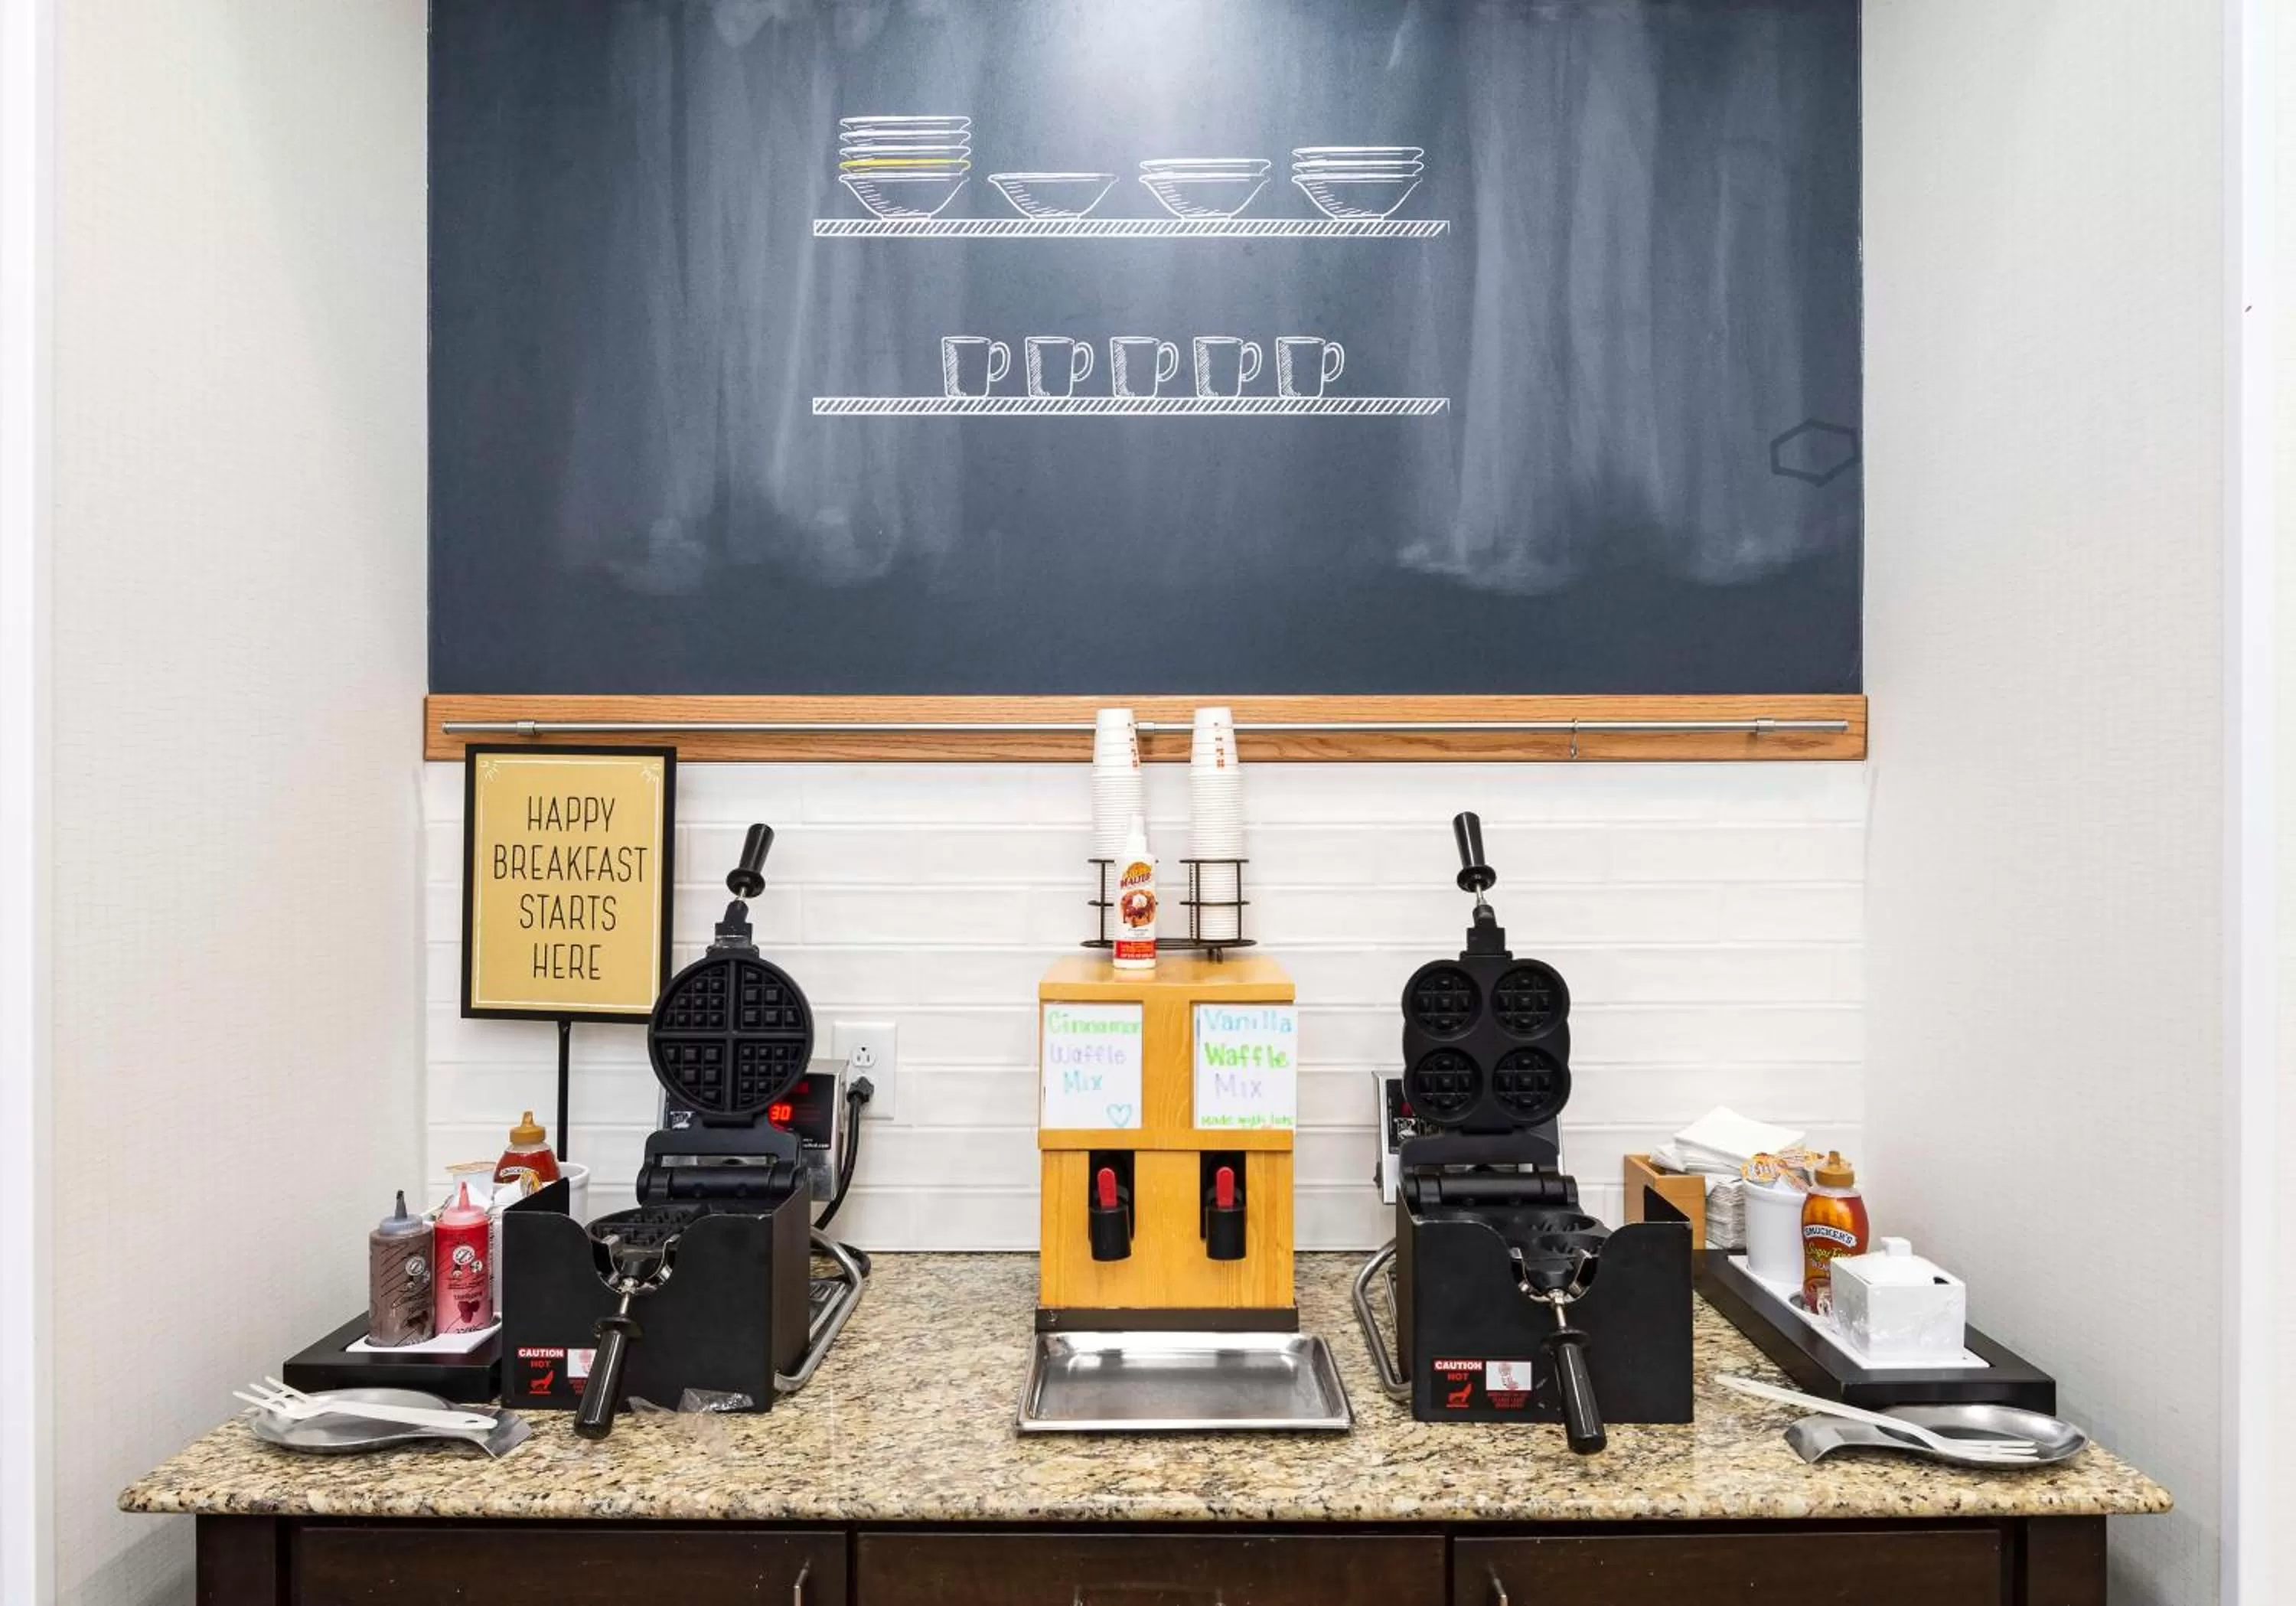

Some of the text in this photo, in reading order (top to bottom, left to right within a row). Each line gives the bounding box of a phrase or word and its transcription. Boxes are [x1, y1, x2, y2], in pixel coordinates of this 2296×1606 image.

[527, 796, 615, 833] HAPPY
[494, 844, 648, 883] BREAKFAST
[520, 894, 617, 932] STARTS
[533, 942, 602, 981] HERE
[1204, 1008, 1293, 1033] Vanilla
[1050, 1043, 1127, 1066] Waffle
[1204, 1041, 1290, 1069] Waffle
[1062, 1069, 1103, 1094] Mix
[1215, 1072, 1263, 1099] Mix
[771, 1105, 791, 1121] 30
[1805, 1226, 1854, 1245] SMUCKER'S
[517, 1349, 564, 1358] CAUTION
[530, 1360, 552, 1369] HOT
[1433, 1360, 1482, 1371] CAUTION
[1446, 1373, 1470, 1382] HOT
